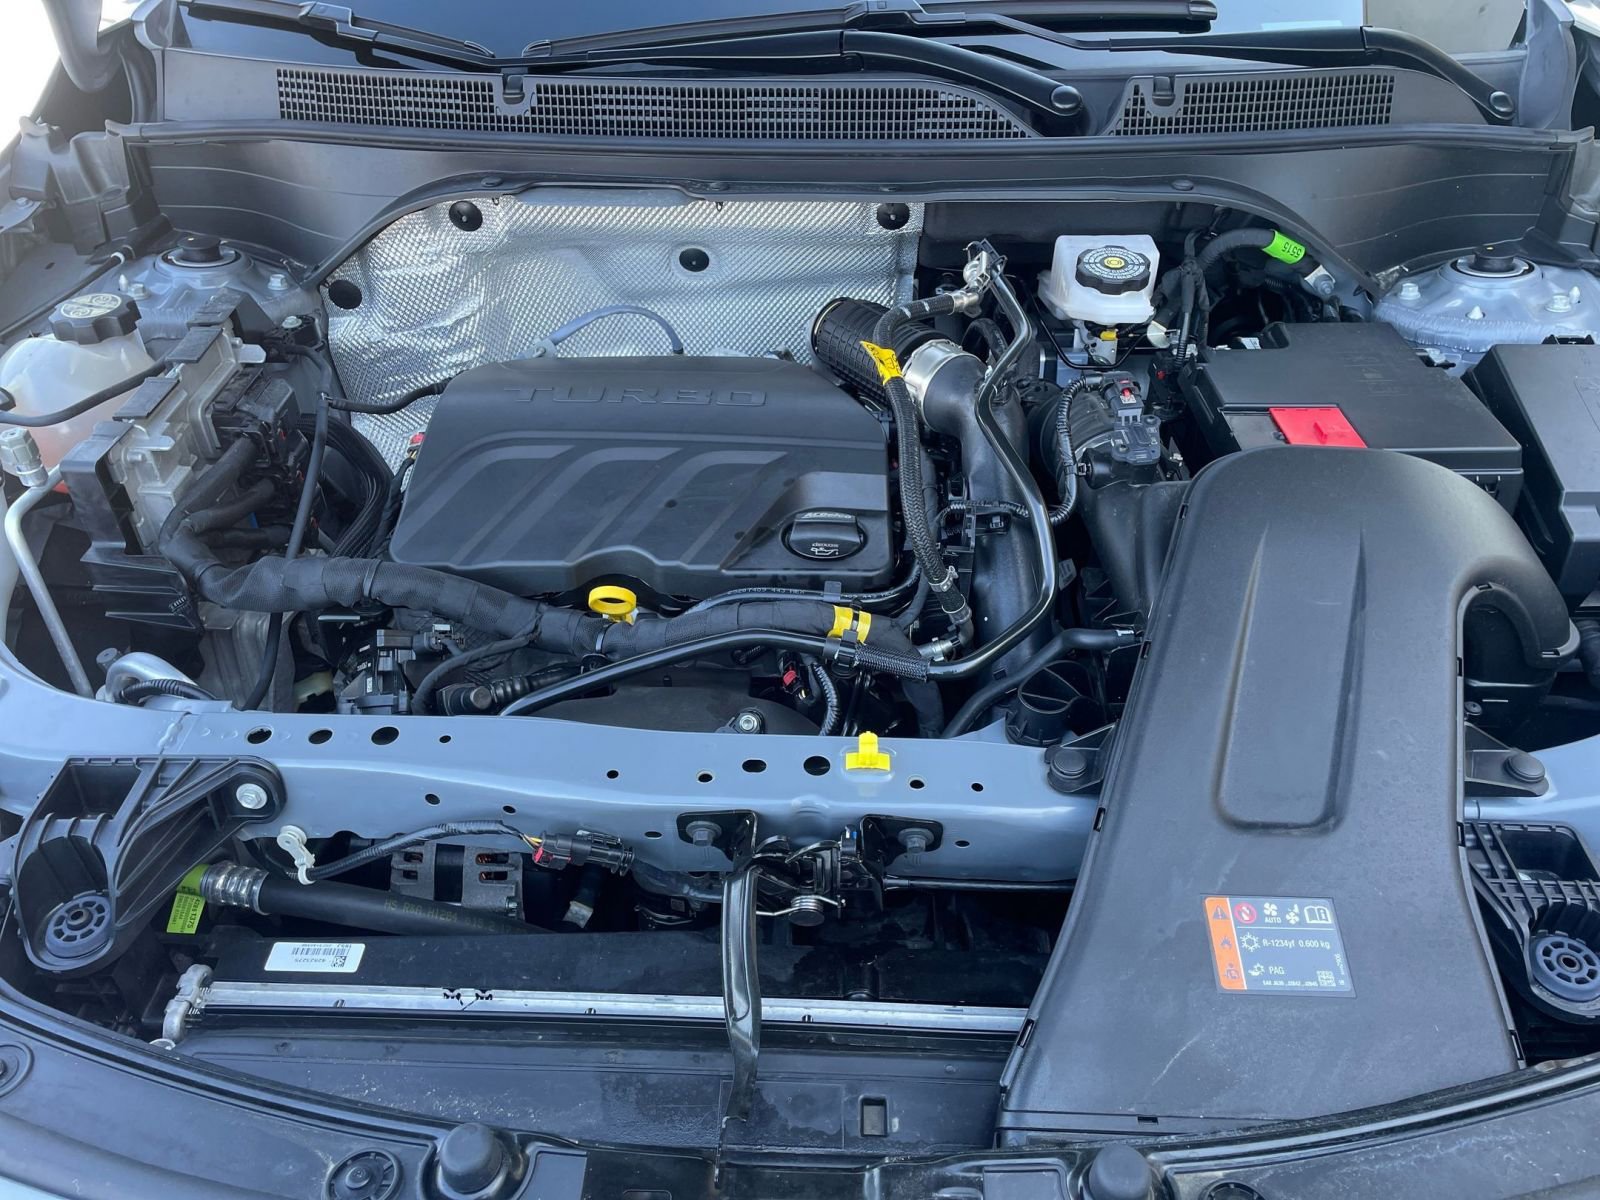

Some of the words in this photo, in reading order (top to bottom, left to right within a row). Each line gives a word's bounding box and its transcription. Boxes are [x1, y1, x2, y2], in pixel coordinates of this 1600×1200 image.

[503, 387, 768, 407] TURBO
[1264, 916, 1282, 924] AUTO
[1262, 938, 1295, 949] R-1234yf
[1298, 939, 1319, 948] 0.600
[1320, 940, 1331, 950] kg
[1268, 966, 1285, 975] PAG
